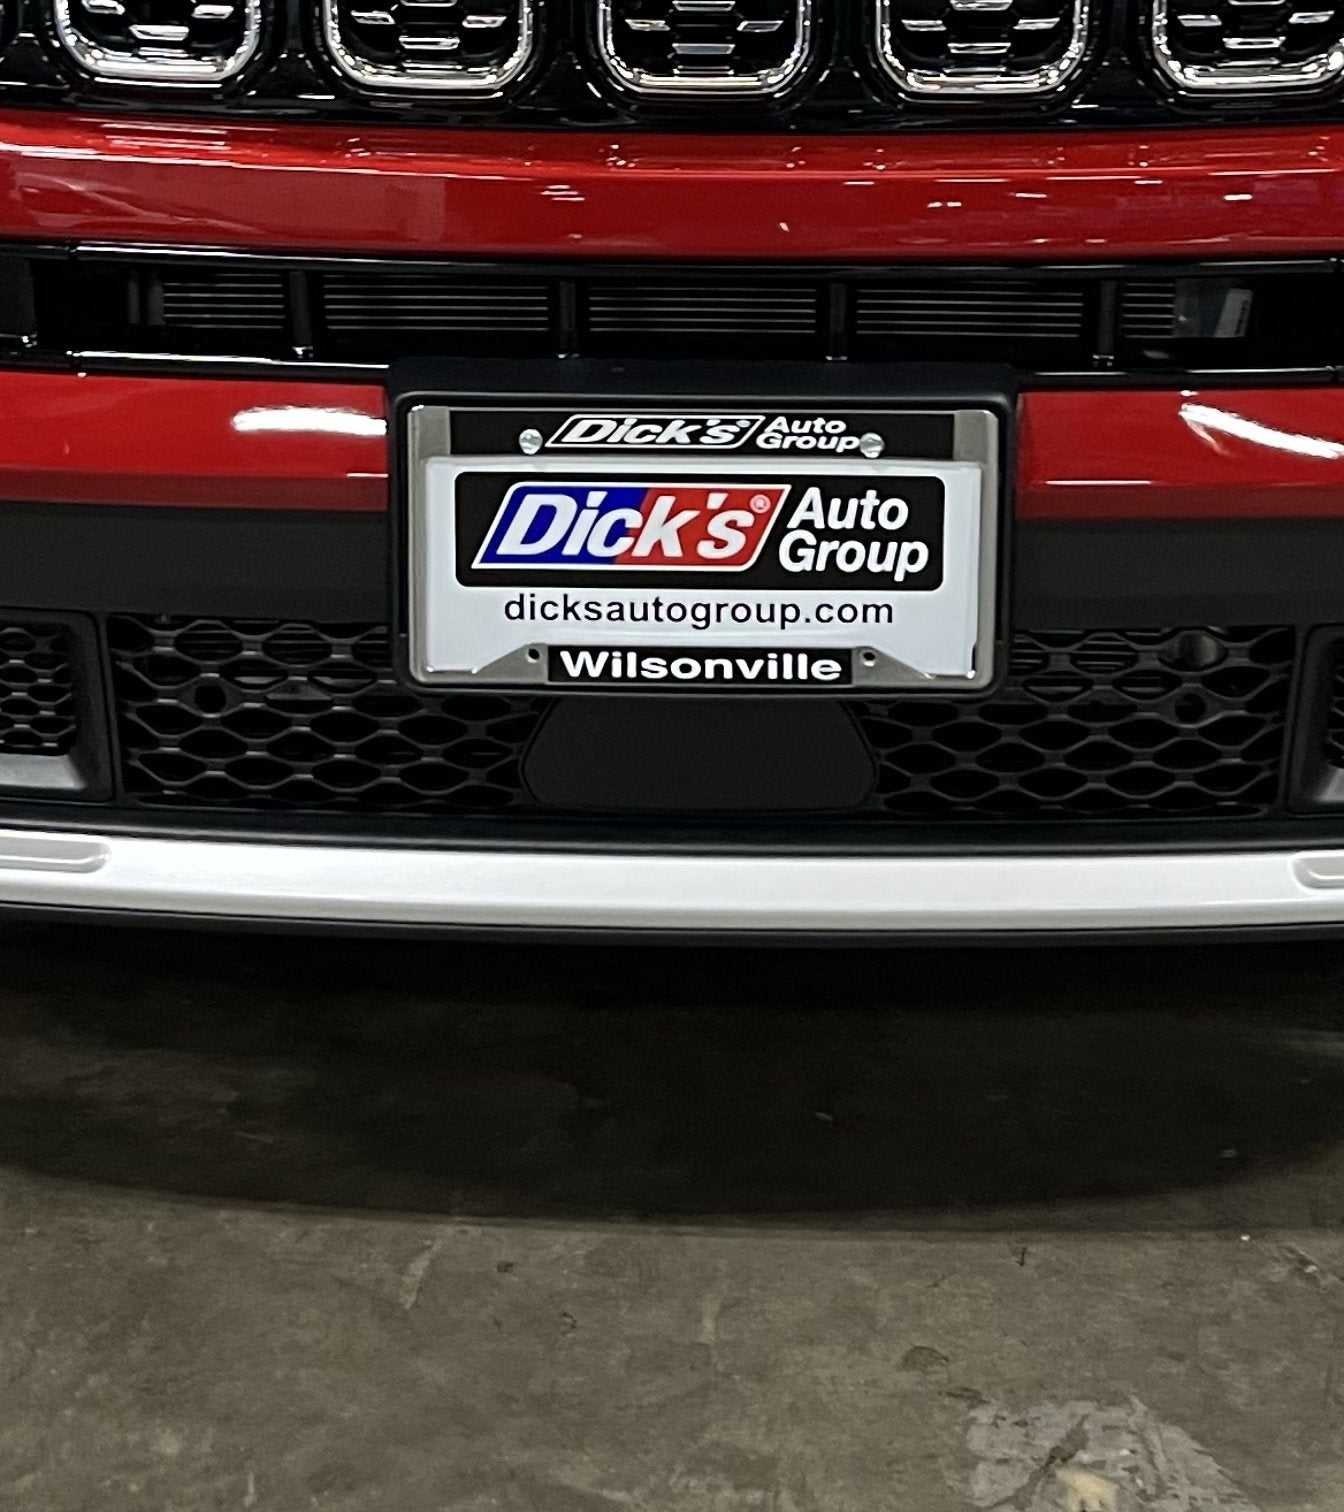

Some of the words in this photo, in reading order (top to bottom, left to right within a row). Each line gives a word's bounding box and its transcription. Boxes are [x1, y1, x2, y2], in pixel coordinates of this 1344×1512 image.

[560, 416, 746, 445] Dick's
[758, 416, 846, 434] Auto
[757, 432, 859, 453] Group
[786, 487, 909, 530] Auto
[778, 530, 930, 581] Group
[504, 593, 894, 629] dicksautogroup.com
[559, 649, 843, 682] Wilsonville
